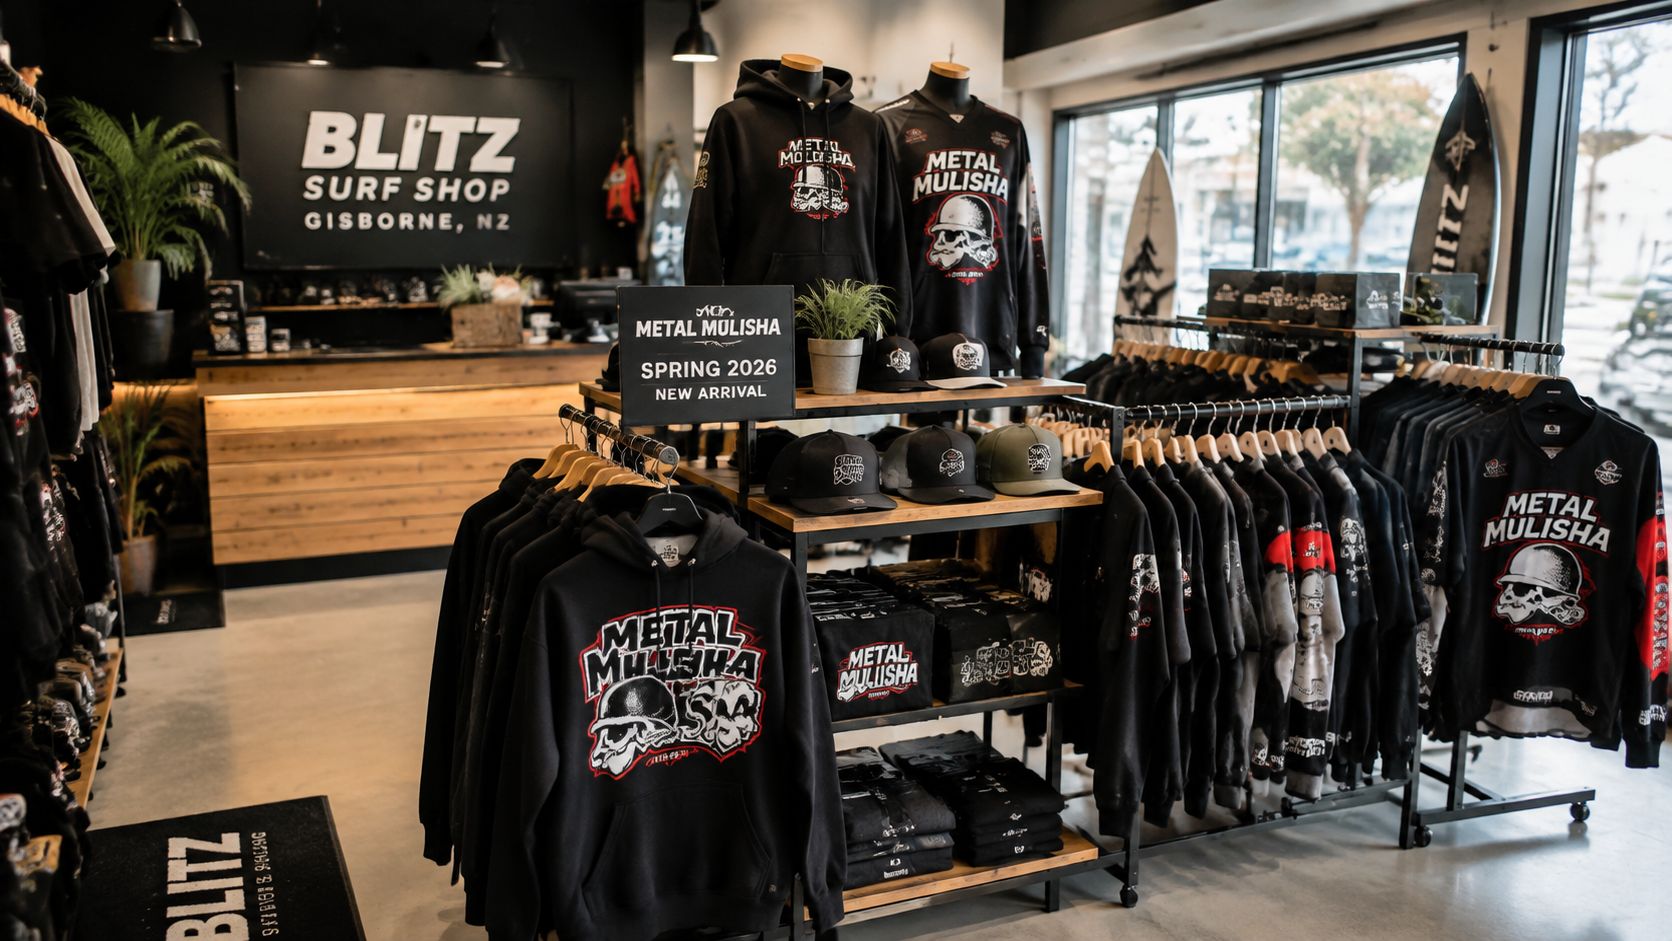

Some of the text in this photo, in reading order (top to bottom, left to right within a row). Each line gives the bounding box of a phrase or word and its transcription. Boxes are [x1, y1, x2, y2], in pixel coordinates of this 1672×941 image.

[301, 110, 521, 173] BLITZ
[925, 150, 1001, 174] METAL
[303, 175, 511, 203] SURF SHOP
[912, 171, 1008, 202] MULISHA
[304, 212, 511, 234] GISBORNE, NZ
[635, 317, 782, 338] METAL MULISHA
[641, 358, 778, 380] SPRING 2026
[655, 384, 767, 401] NEW ARRIVAL
[1502, 492, 1598, 522] METAL
[1483, 516, 1611, 553] MULISHA
[601, 608, 747, 656] METAL
[848, 644, 910, 670] METAL
[165, 831, 250, 941] BLITZ
